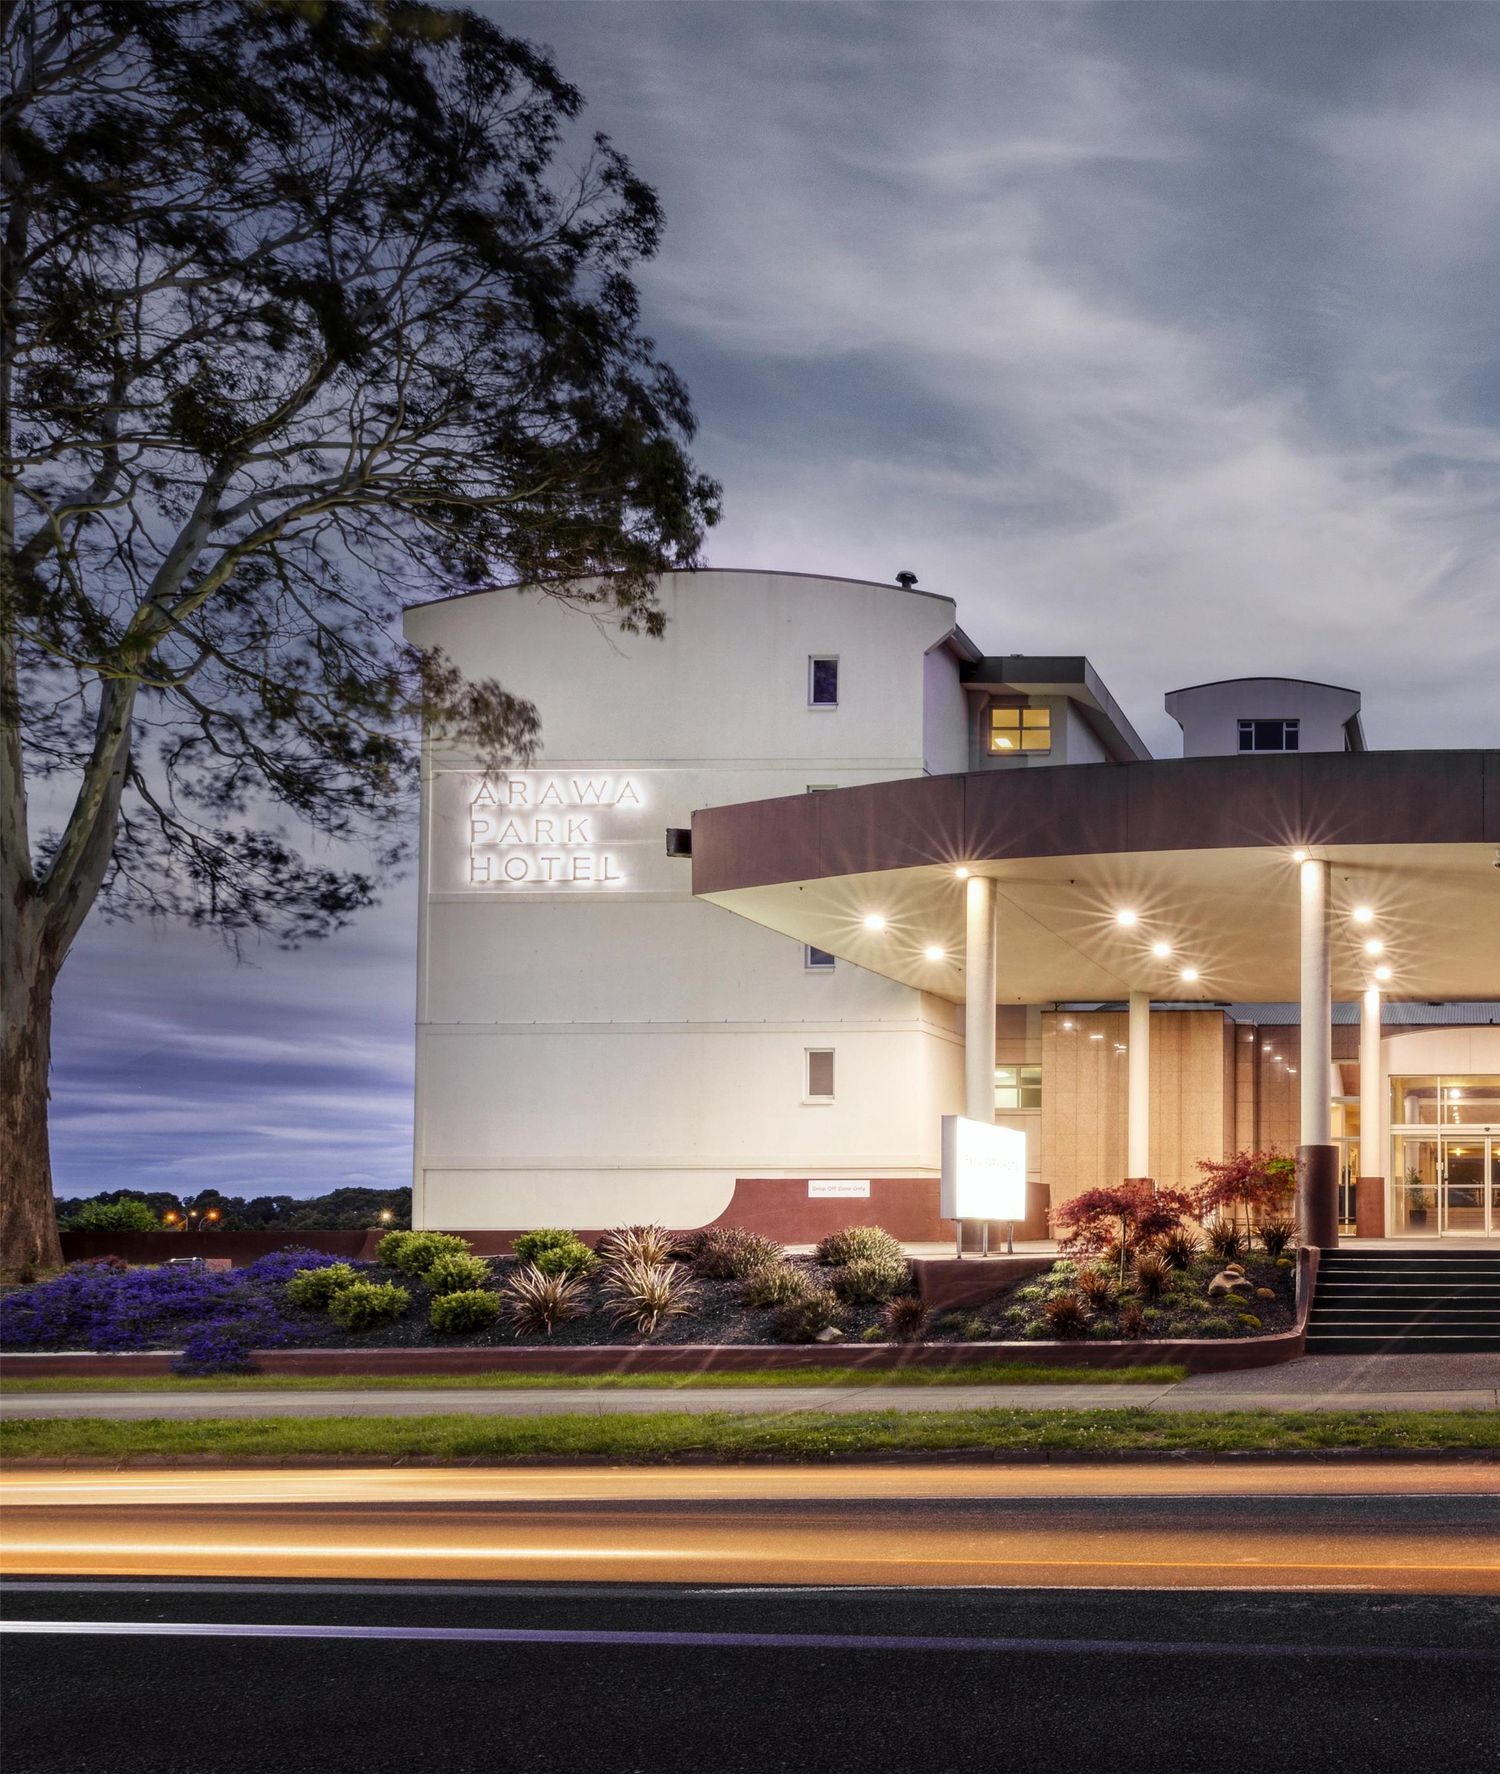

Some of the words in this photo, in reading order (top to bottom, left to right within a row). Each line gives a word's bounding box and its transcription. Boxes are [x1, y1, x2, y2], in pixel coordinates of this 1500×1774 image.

[472, 780, 640, 804] ARAWA
[471, 818, 588, 843] PARK
[470, 856, 620, 881] HOTEL
